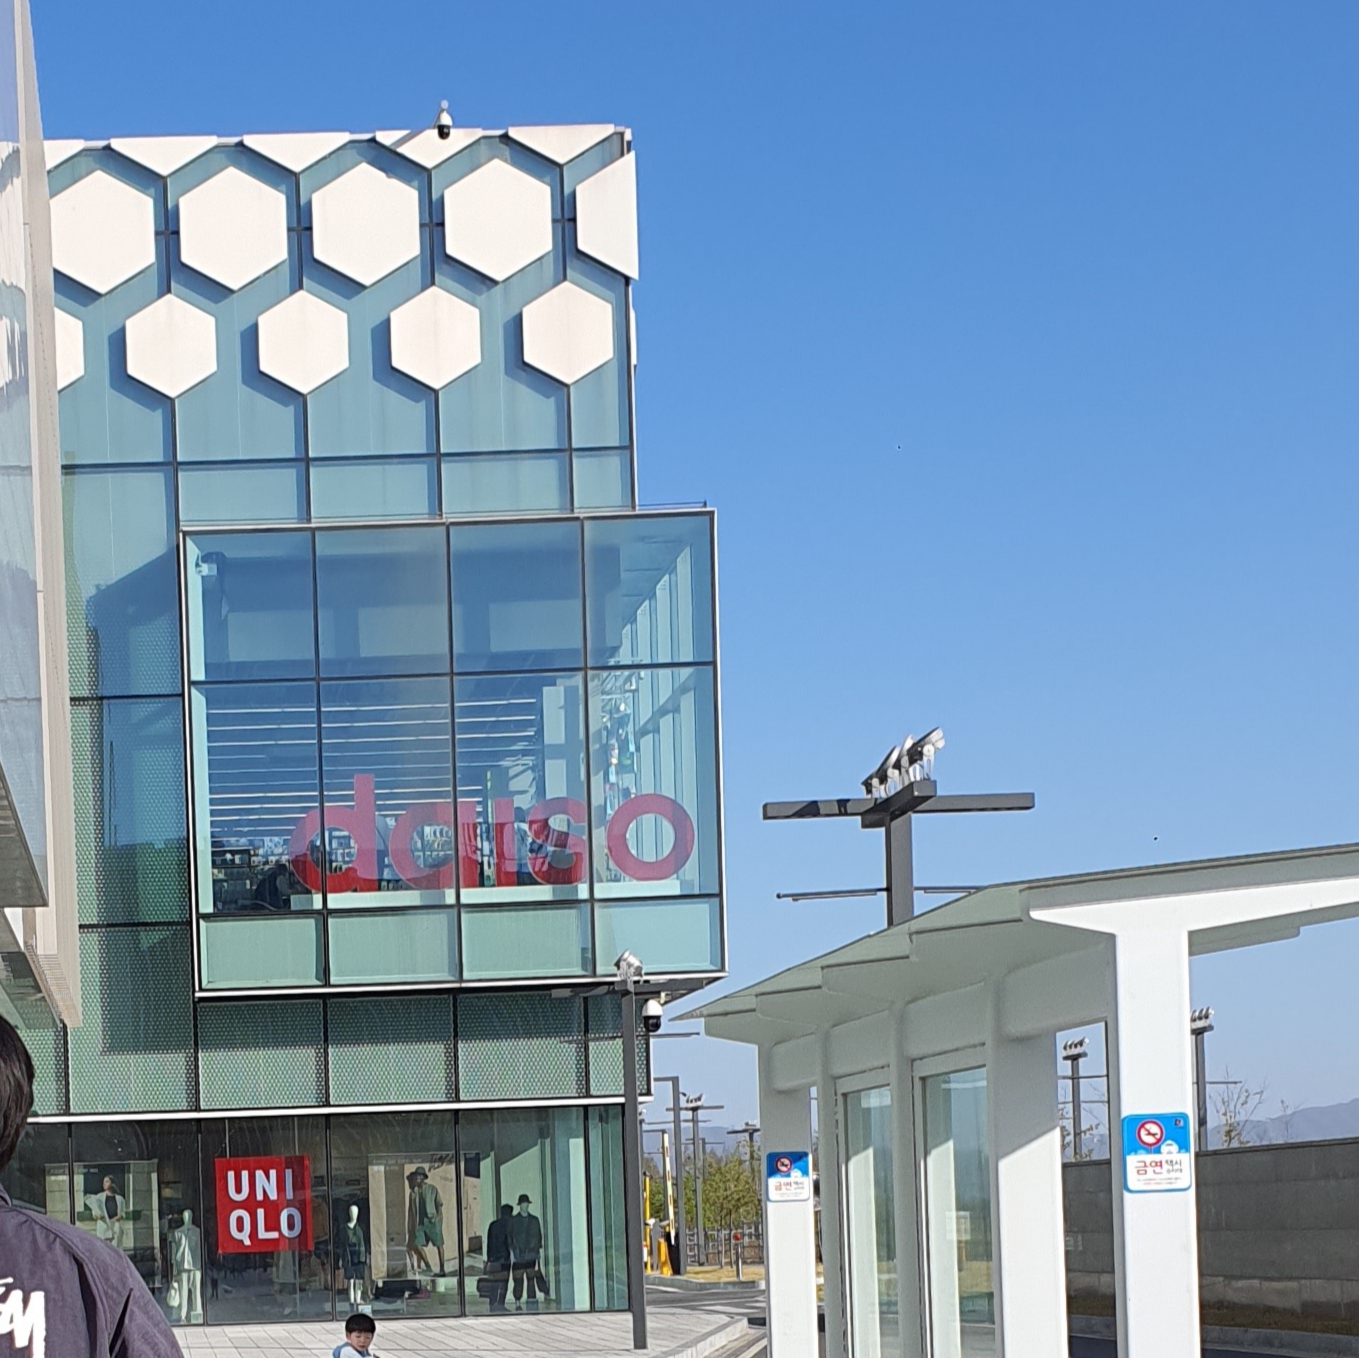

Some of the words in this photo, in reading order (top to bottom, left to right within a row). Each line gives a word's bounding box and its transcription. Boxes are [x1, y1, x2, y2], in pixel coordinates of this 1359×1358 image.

[288, 772, 696, 894] daiso
[227, 1168, 294, 1202] UNI
[1135, 1160, 1163, 1175] 금연
[229, 1207, 302, 1246] QLO
